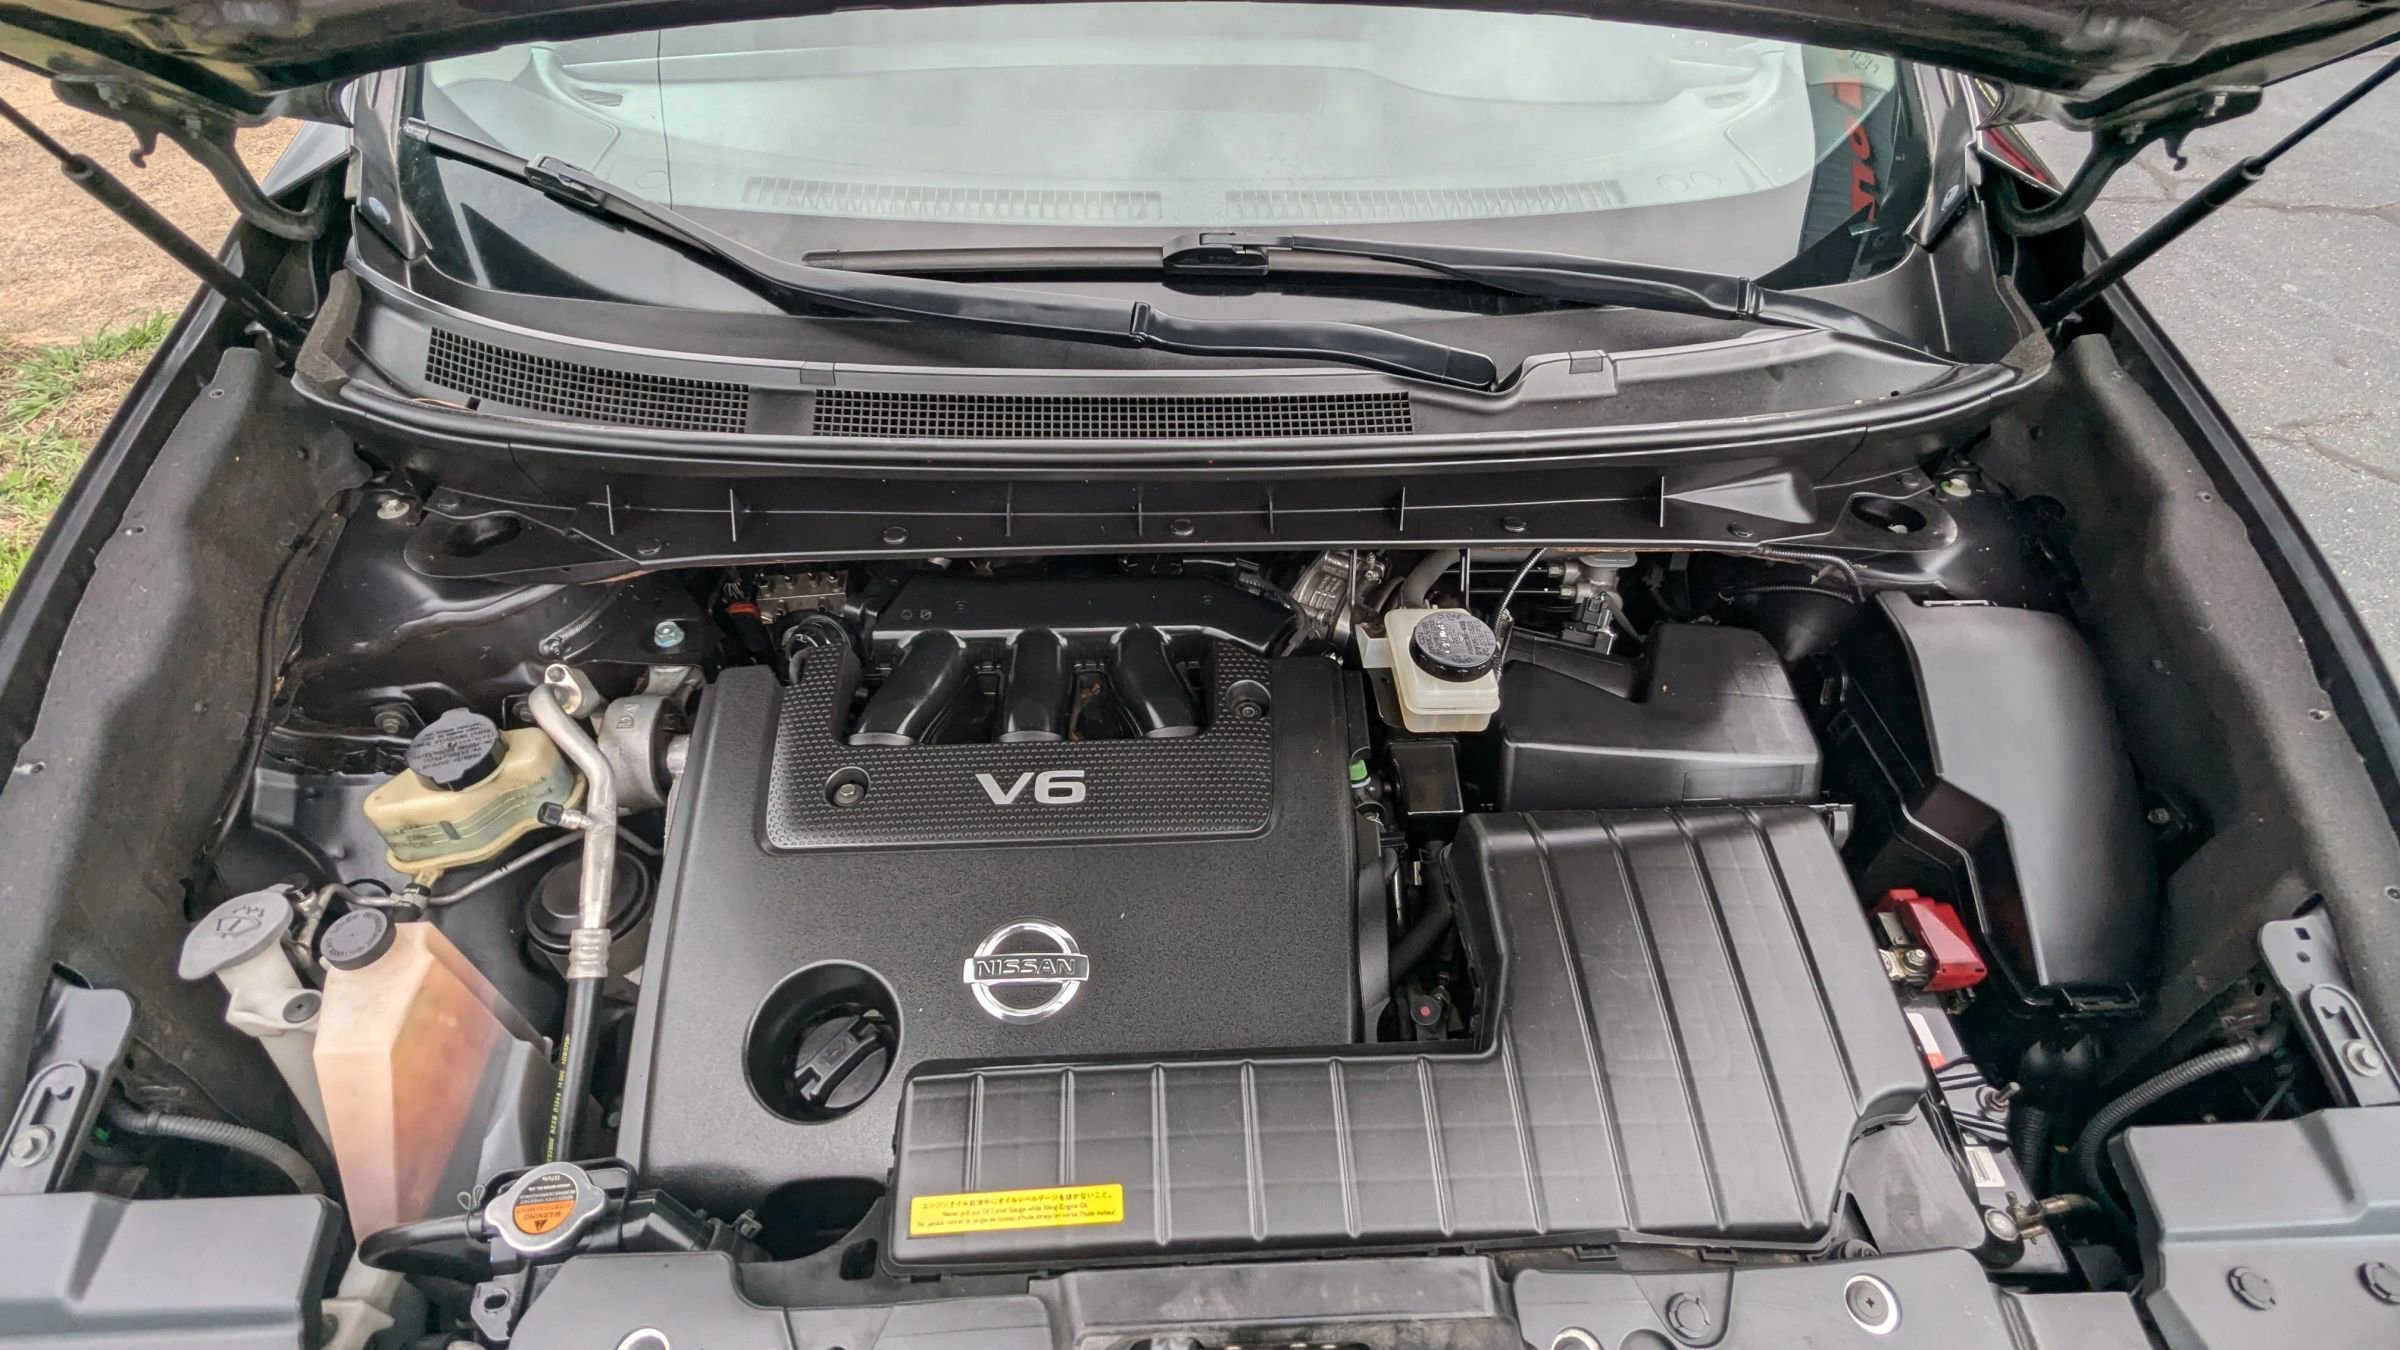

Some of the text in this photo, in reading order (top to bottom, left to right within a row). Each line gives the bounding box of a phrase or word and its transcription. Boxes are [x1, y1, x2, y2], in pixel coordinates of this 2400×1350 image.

[975, 770, 1086, 805] V6
[976, 958, 1076, 976] NISSAN
[1059, 1203, 1079, 1211] Engine
